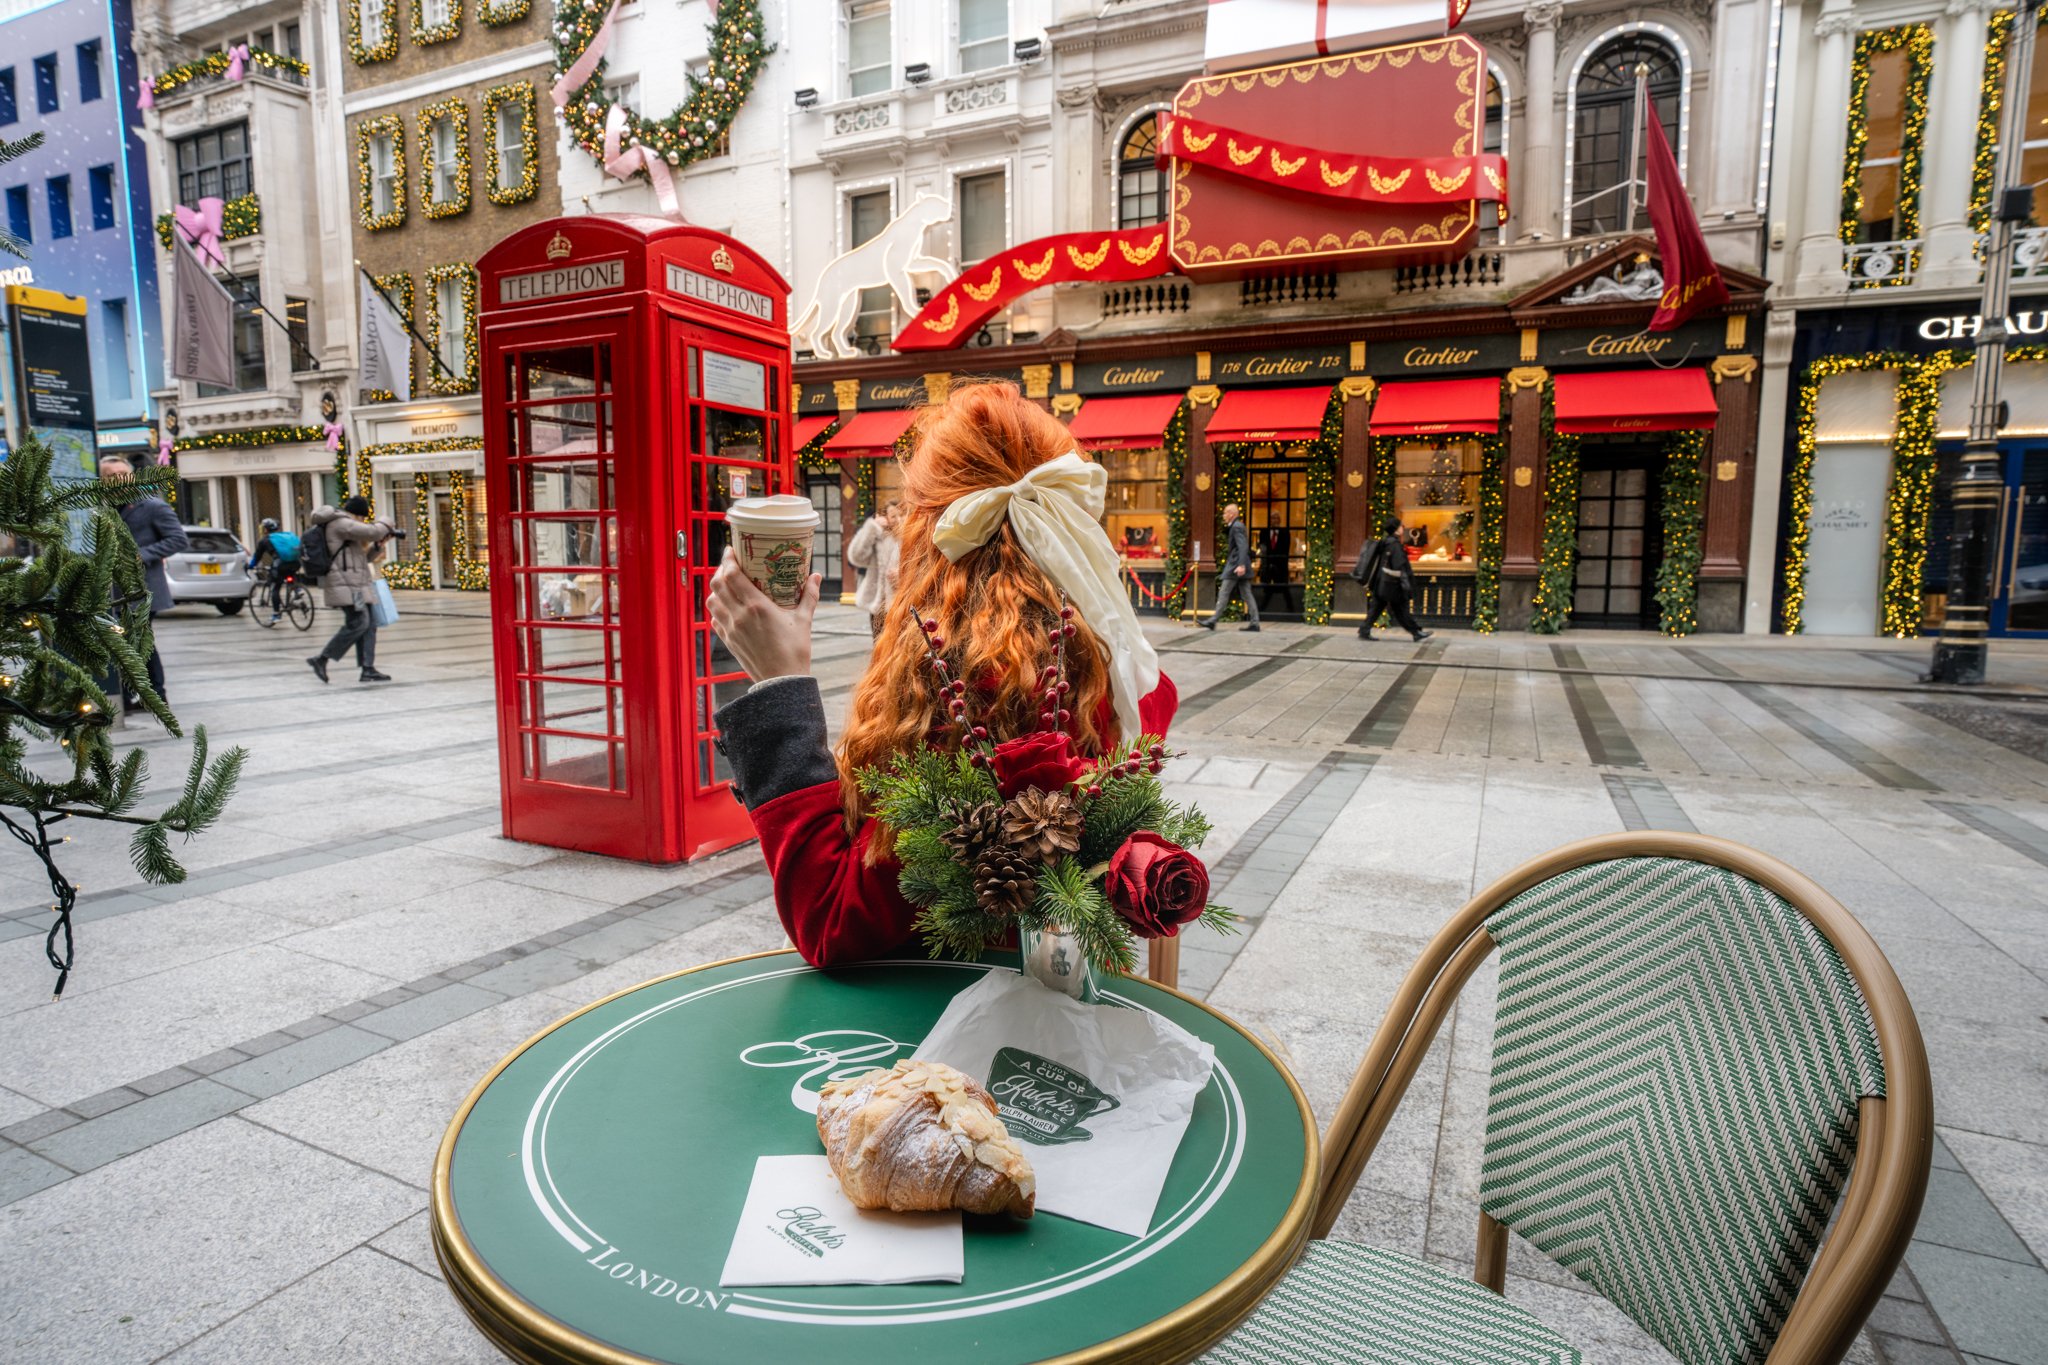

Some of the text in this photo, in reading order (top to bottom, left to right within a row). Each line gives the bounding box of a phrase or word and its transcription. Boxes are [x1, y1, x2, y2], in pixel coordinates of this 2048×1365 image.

[505, 262, 622, 300] TELEPHONE
[670, 267, 770, 319] TELEPHONE
[1403, 346, 1479, 368] Cartier
[1586, 334, 1672, 357] Cartier
[1102, 366, 1165, 387] Cartier
[1221, 355, 1342, 377] 176 Cartier 175
[811, 393, 826, 405] 177
[870, 385, 914, 400] Cartier
[411, 423, 458, 436] MIKIMOTO
[1019, 1061, 1086, 1094] A CUP OF
[1041, 1061, 1069, 1076] ENJOY
[991, 1075, 1075, 1117] Ralph's
[1000, 1106, 1055, 1132] RALPH LAUREN
[1019, 1101, 1068, 1124] COFFEE
[1009, 1123, 1028, 1133] YORK
[776, 1206, 847, 1250] Ralph's
[766, 1225, 813, 1258] RALPH LAUREN
[790, 1232, 818, 1254] COFFEE
[587, 1245, 731, 1313] LONDON
